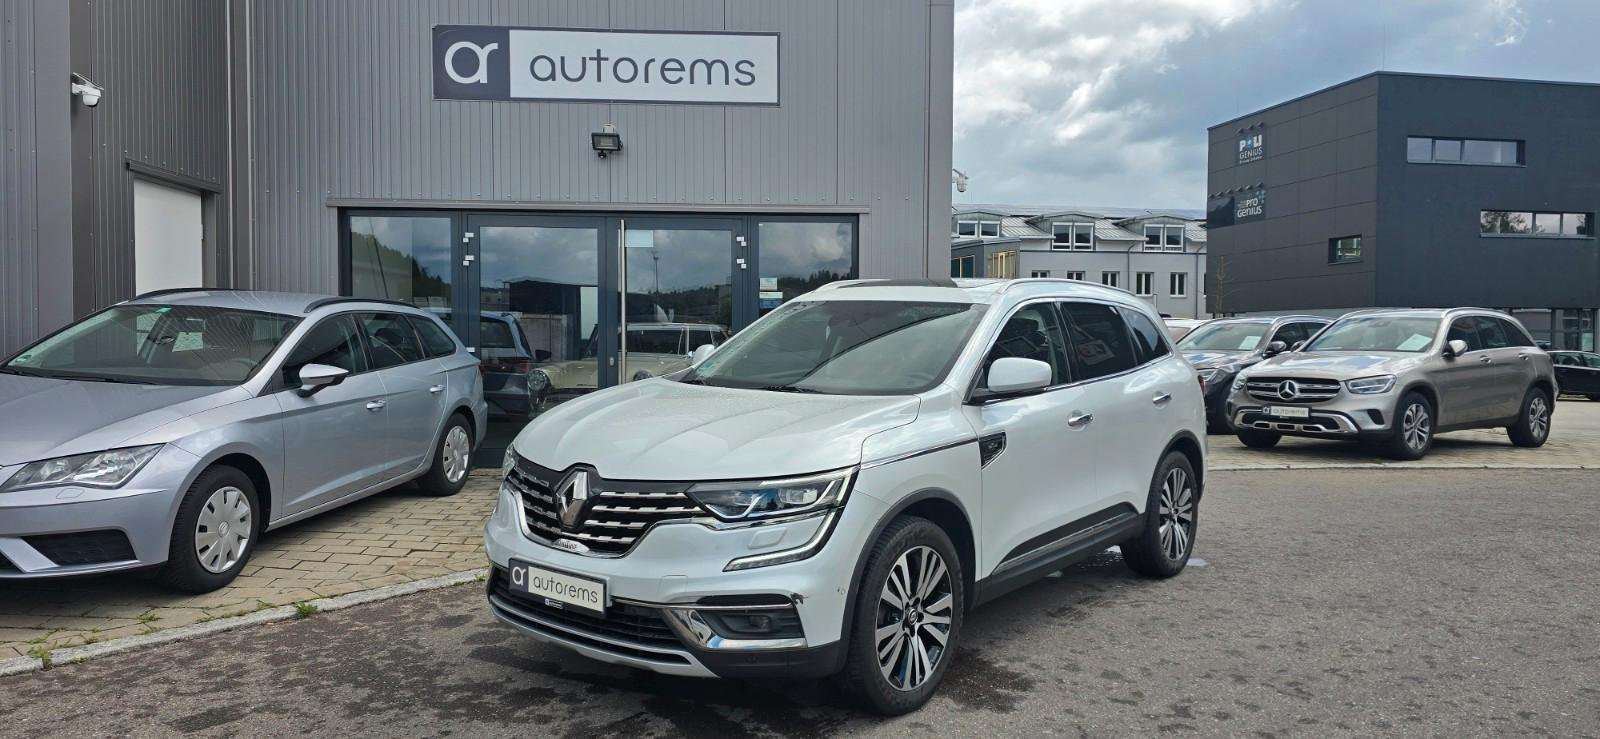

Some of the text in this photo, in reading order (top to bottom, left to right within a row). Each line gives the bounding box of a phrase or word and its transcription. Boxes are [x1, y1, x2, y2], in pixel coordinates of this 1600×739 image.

[530, 48, 756, 86] autorems
[1239, 147, 1263, 160] GENIUS
[533, 575, 598, 603] autorems
